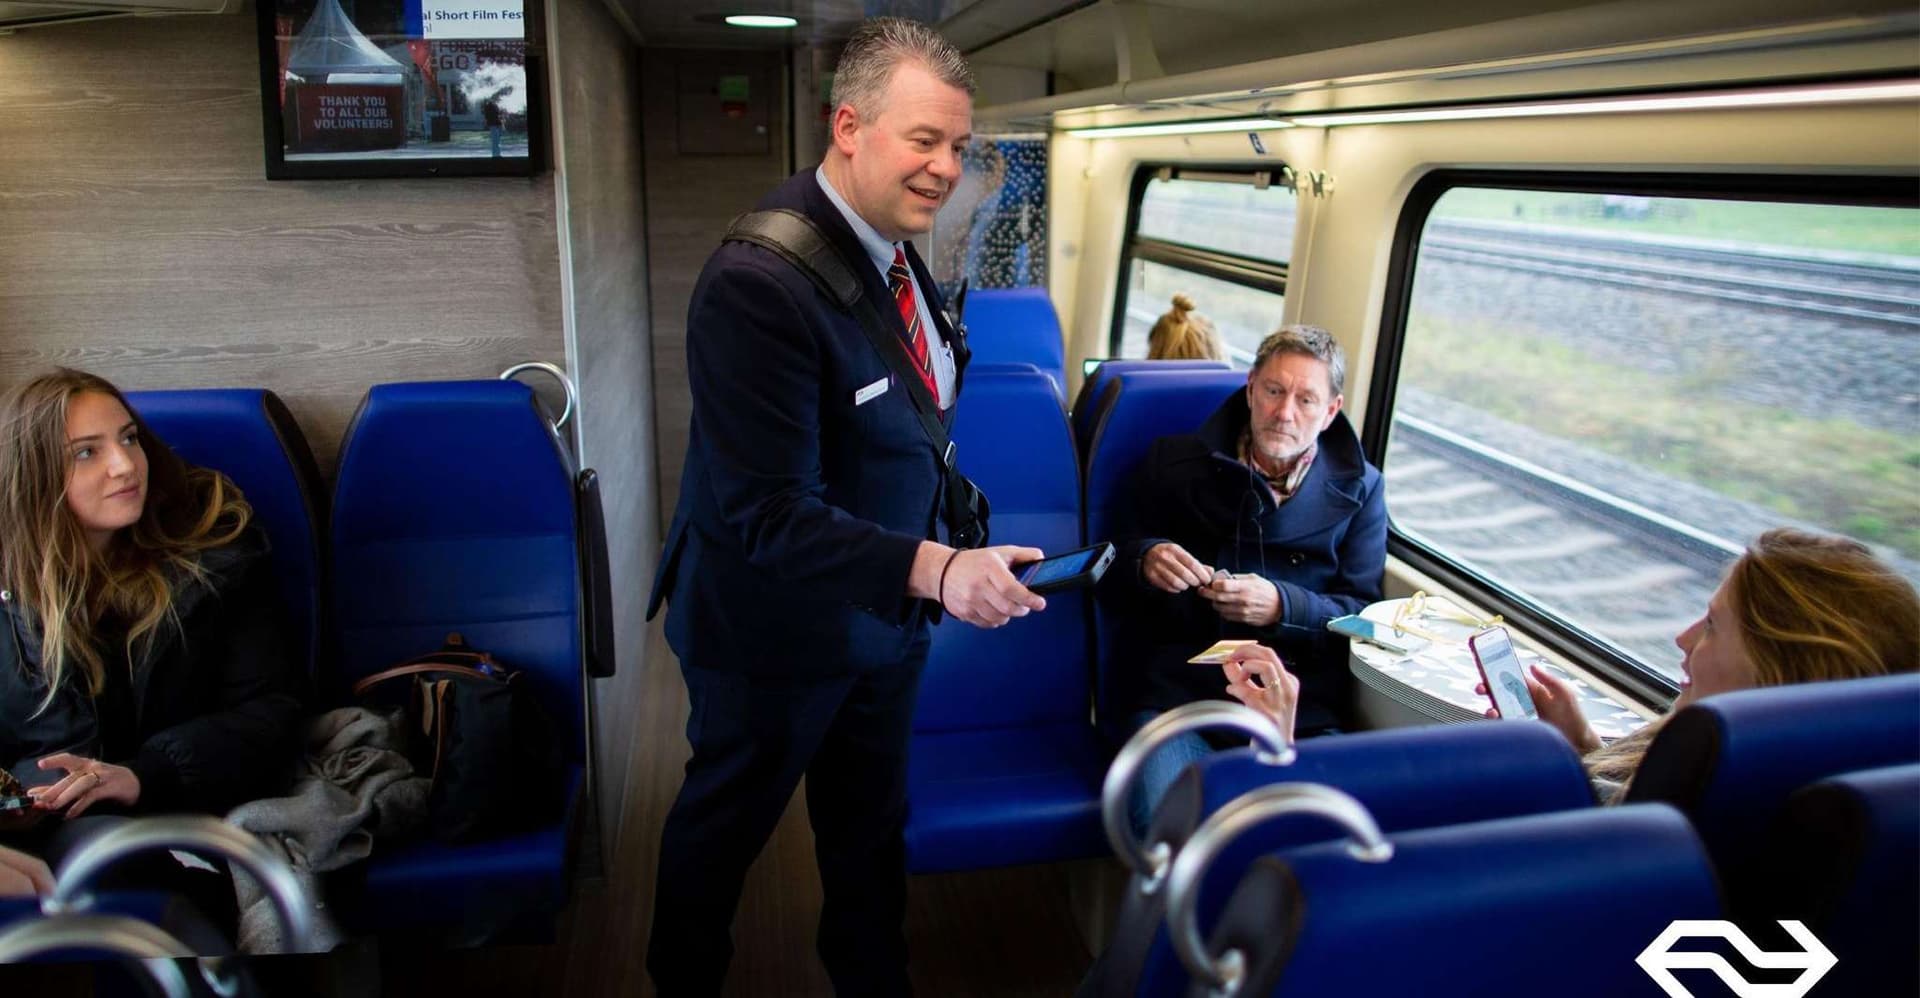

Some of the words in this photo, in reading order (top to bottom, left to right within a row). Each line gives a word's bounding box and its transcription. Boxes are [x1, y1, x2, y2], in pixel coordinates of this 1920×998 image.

[435, 9, 469, 20] Short
[473, 9, 498, 19] Film
[319, 96, 360, 106] THANK
[363, 96, 386, 106] YOU
[320, 107, 336, 118] TO
[339, 107, 361, 118] ALL
[364, 107, 388, 118] OUR
[314, 118, 393, 129] VOLUNTEERS!
